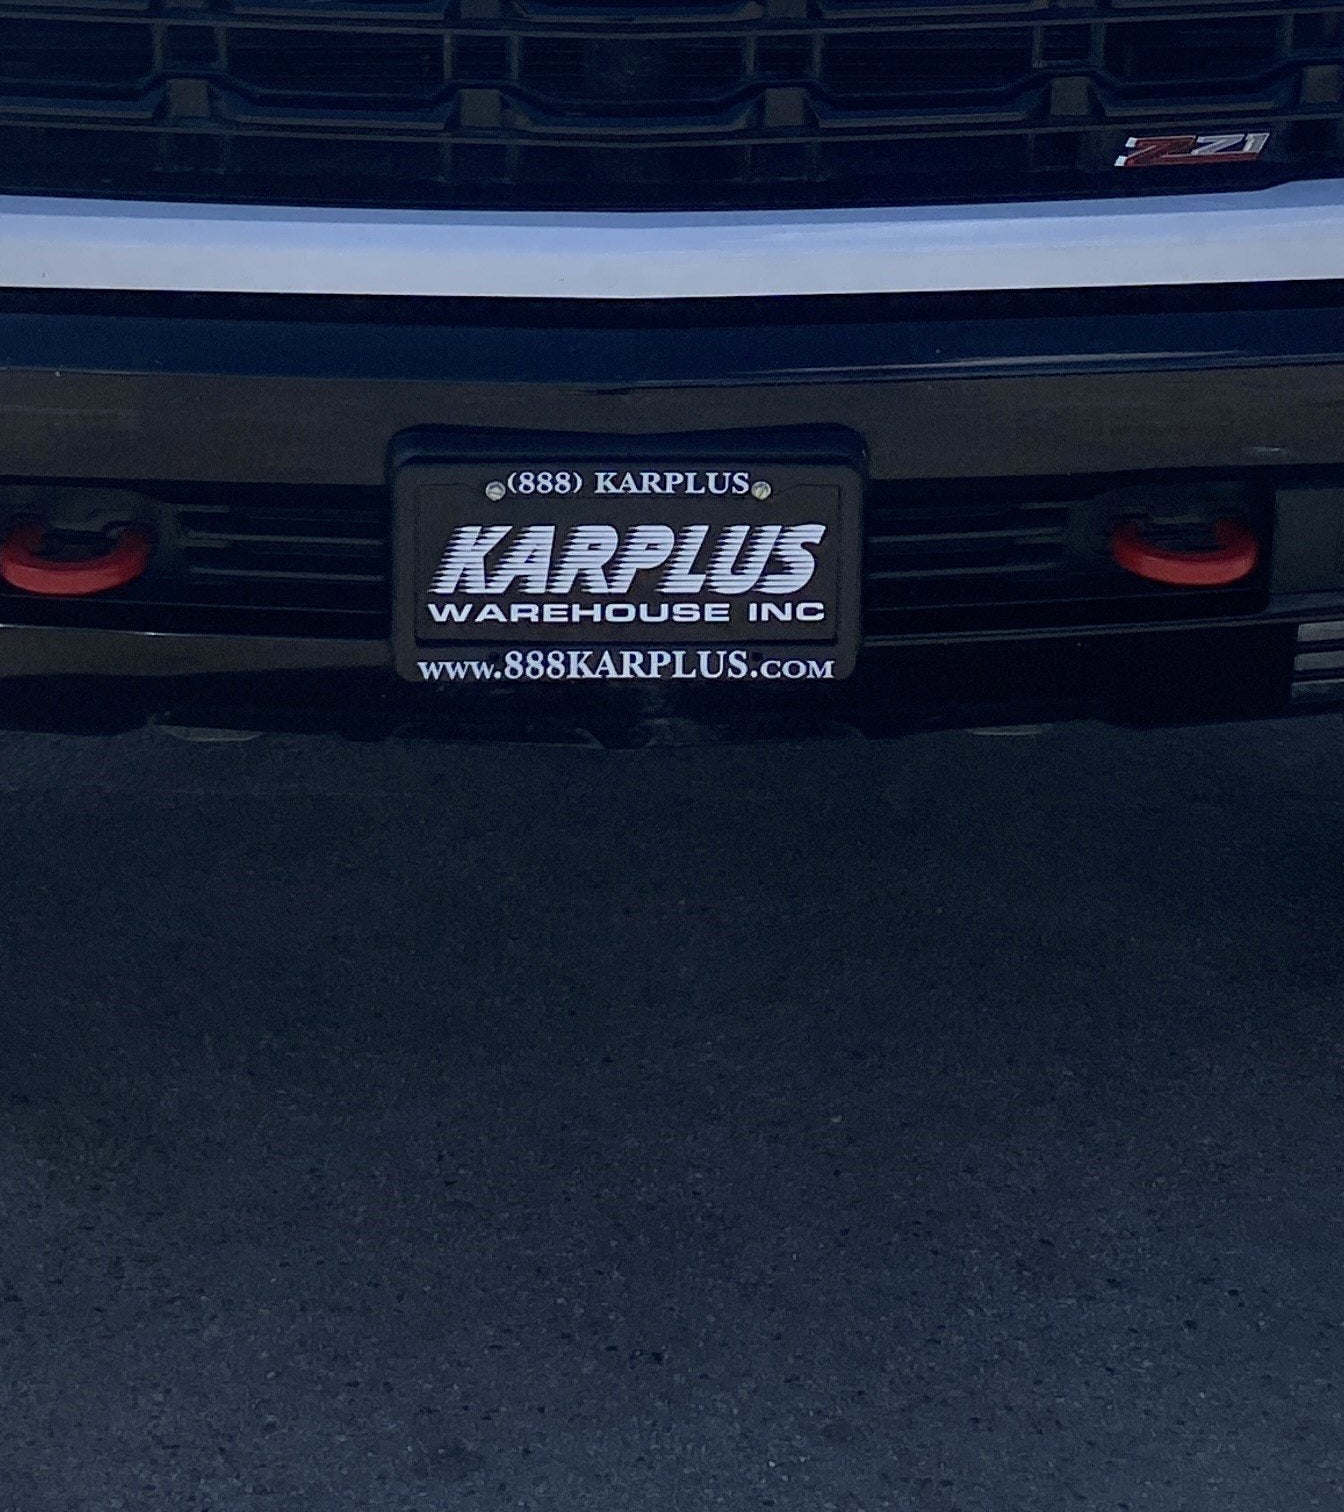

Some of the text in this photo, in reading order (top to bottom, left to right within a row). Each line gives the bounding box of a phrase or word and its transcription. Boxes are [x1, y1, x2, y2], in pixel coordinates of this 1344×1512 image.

[506, 471, 750, 496] (888) KARPLUS
[427, 522, 827, 595] KARPLUS
[427, 602, 826, 623] WAREHOUSE INC
